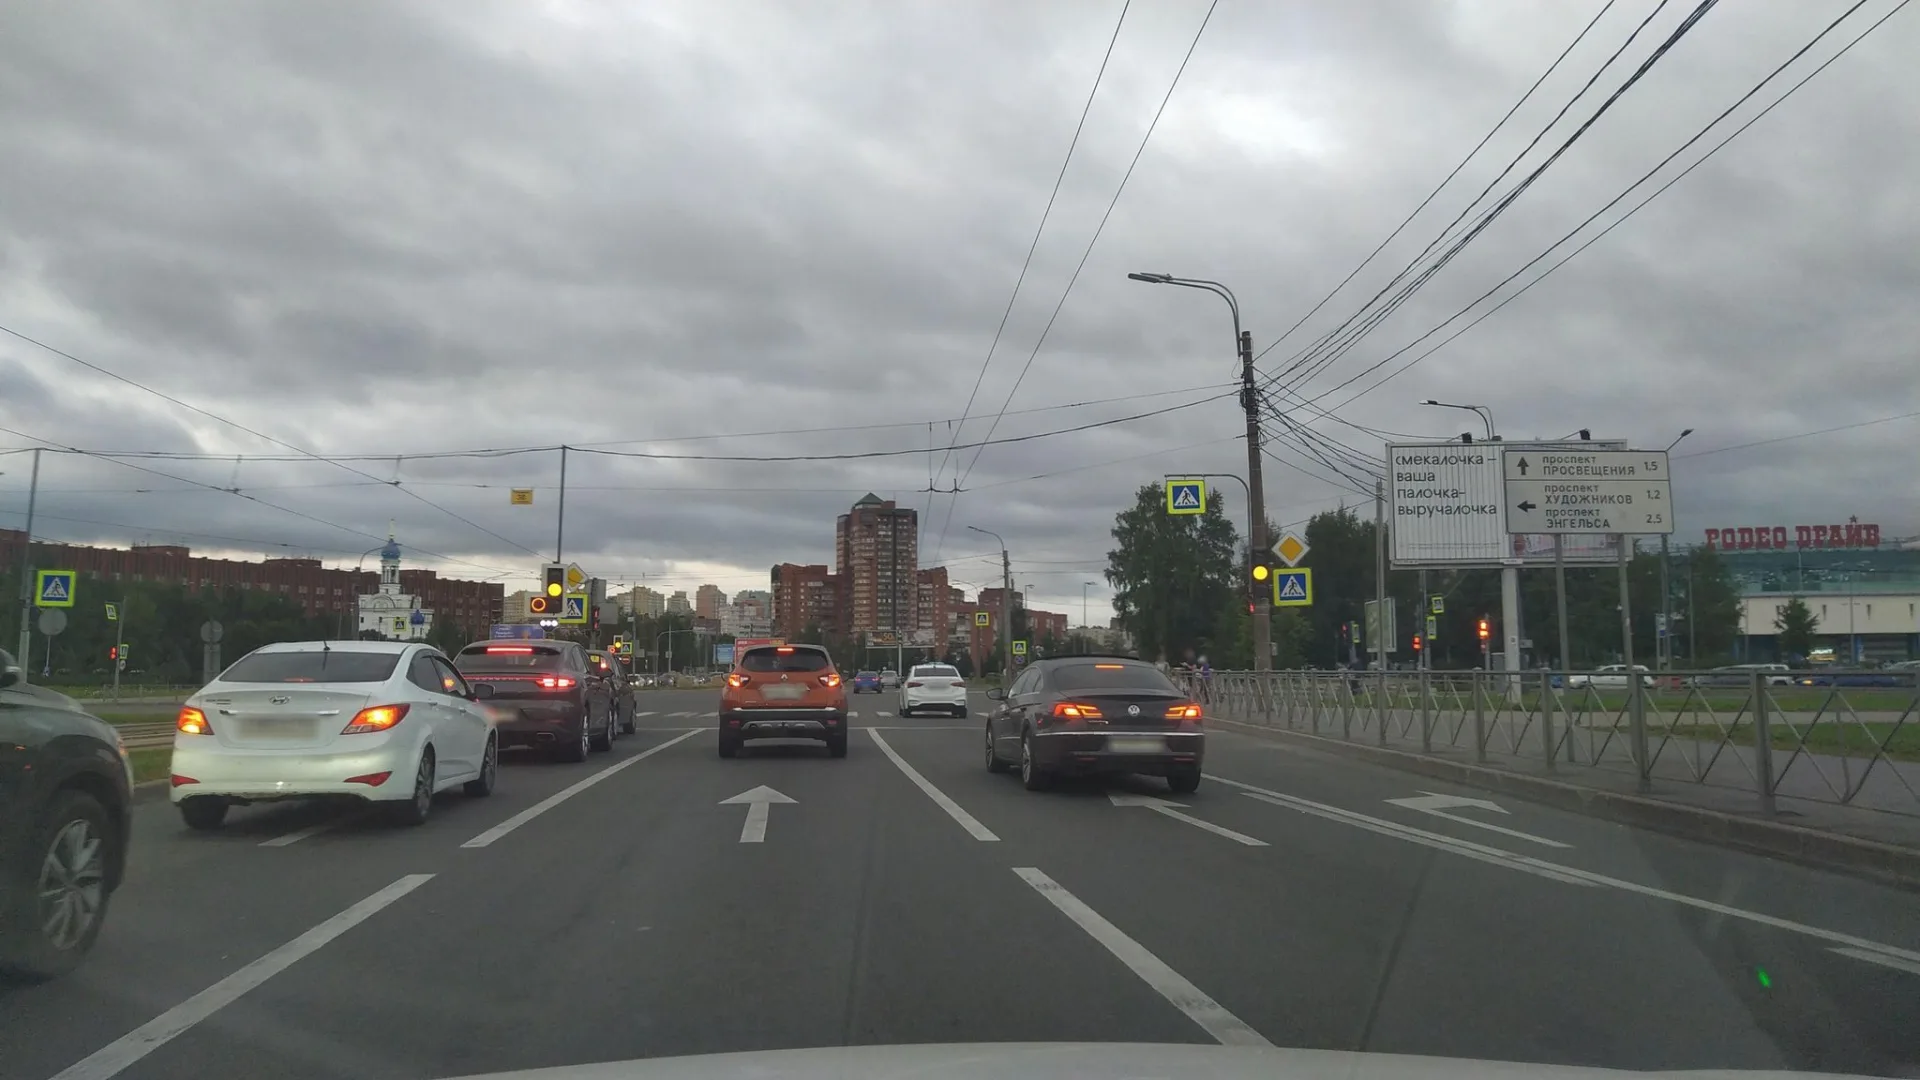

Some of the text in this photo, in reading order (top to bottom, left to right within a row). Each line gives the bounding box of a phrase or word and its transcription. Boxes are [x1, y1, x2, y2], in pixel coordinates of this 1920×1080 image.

[1395, 455, 1484, 465] смекалочка
[1542, 456, 1597, 466] проспект
[1543, 465, 1635, 476] ПРОСВЕЩЕНИЯ
[1396, 472, 1436, 482] ваша
[1544, 484, 1600, 494] проспект
[1545, 494, 1633, 505] ХУДОЖНИКОВ
[1397, 505, 1497, 518] выручалочка
[1545, 508, 1600, 518] проспект
[1546, 518, 1611, 529] ЭНГЕЛЬСА
[1705, 526, 1787, 549] РОДЕО
